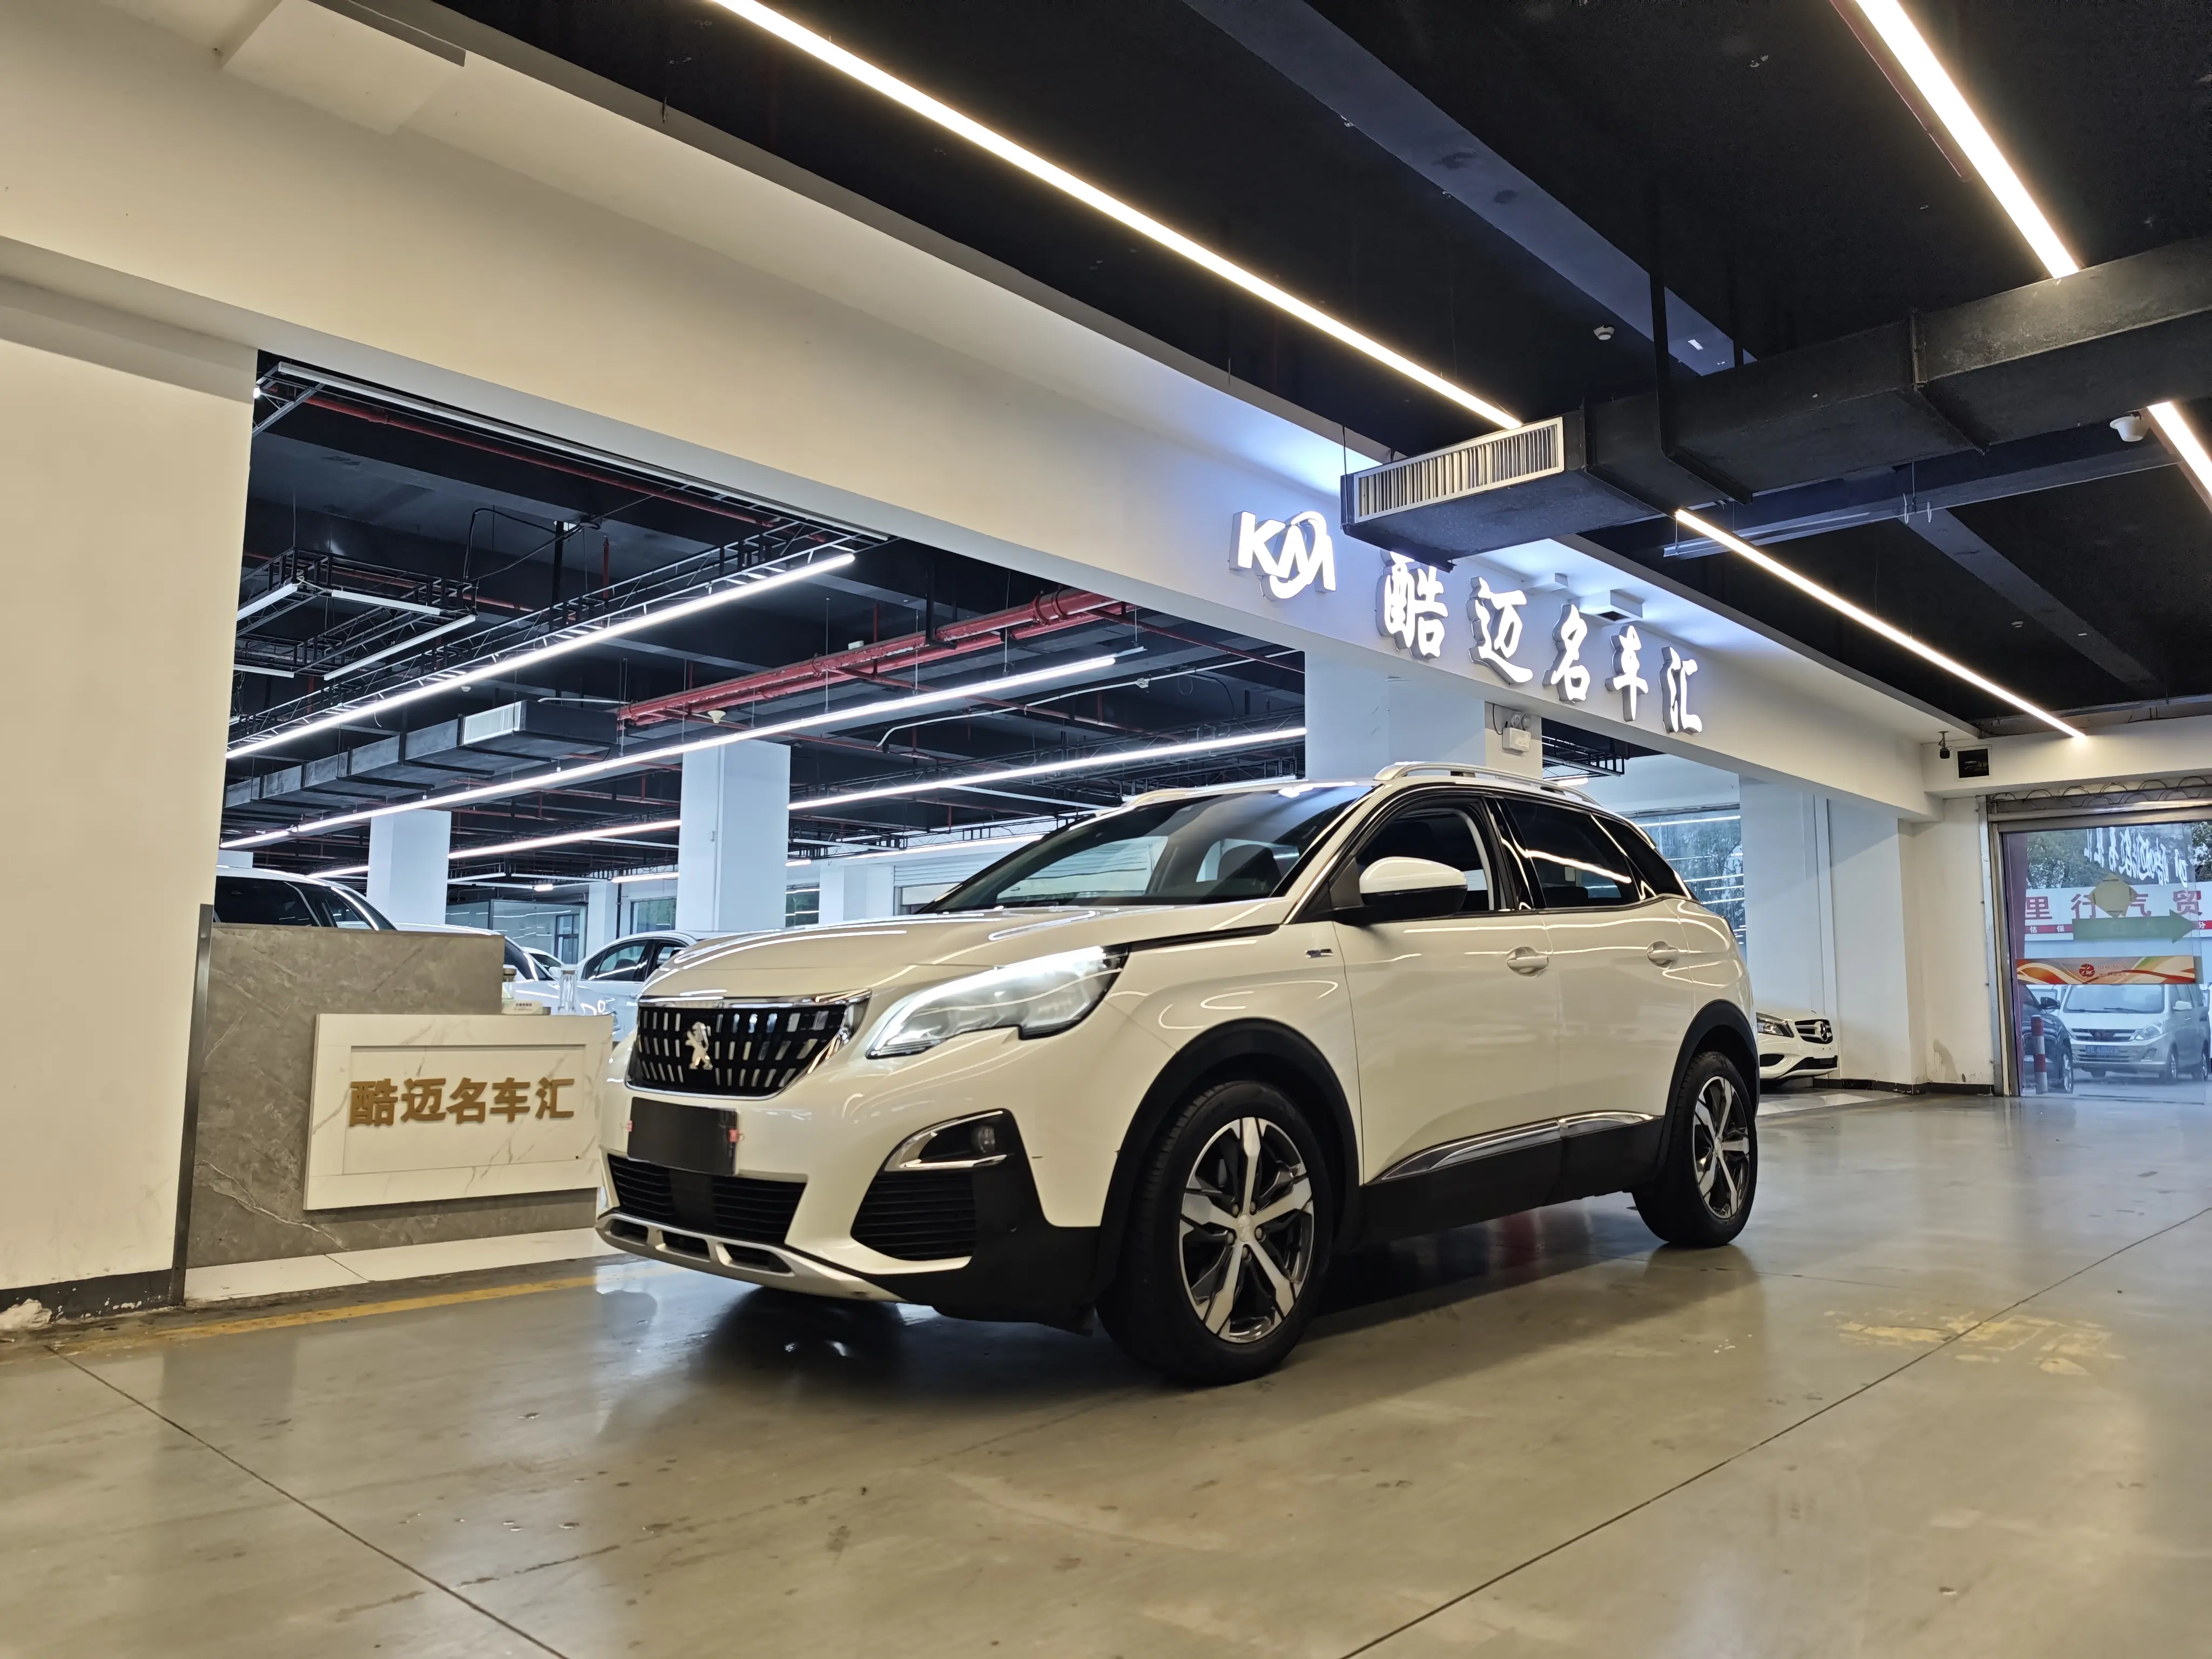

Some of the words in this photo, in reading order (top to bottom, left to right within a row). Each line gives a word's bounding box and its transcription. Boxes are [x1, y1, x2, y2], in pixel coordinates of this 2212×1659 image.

[1378, 550, 1703, 734] 酷迈名车汇
[348, 1077, 575, 1127] 酷迈名车汇
